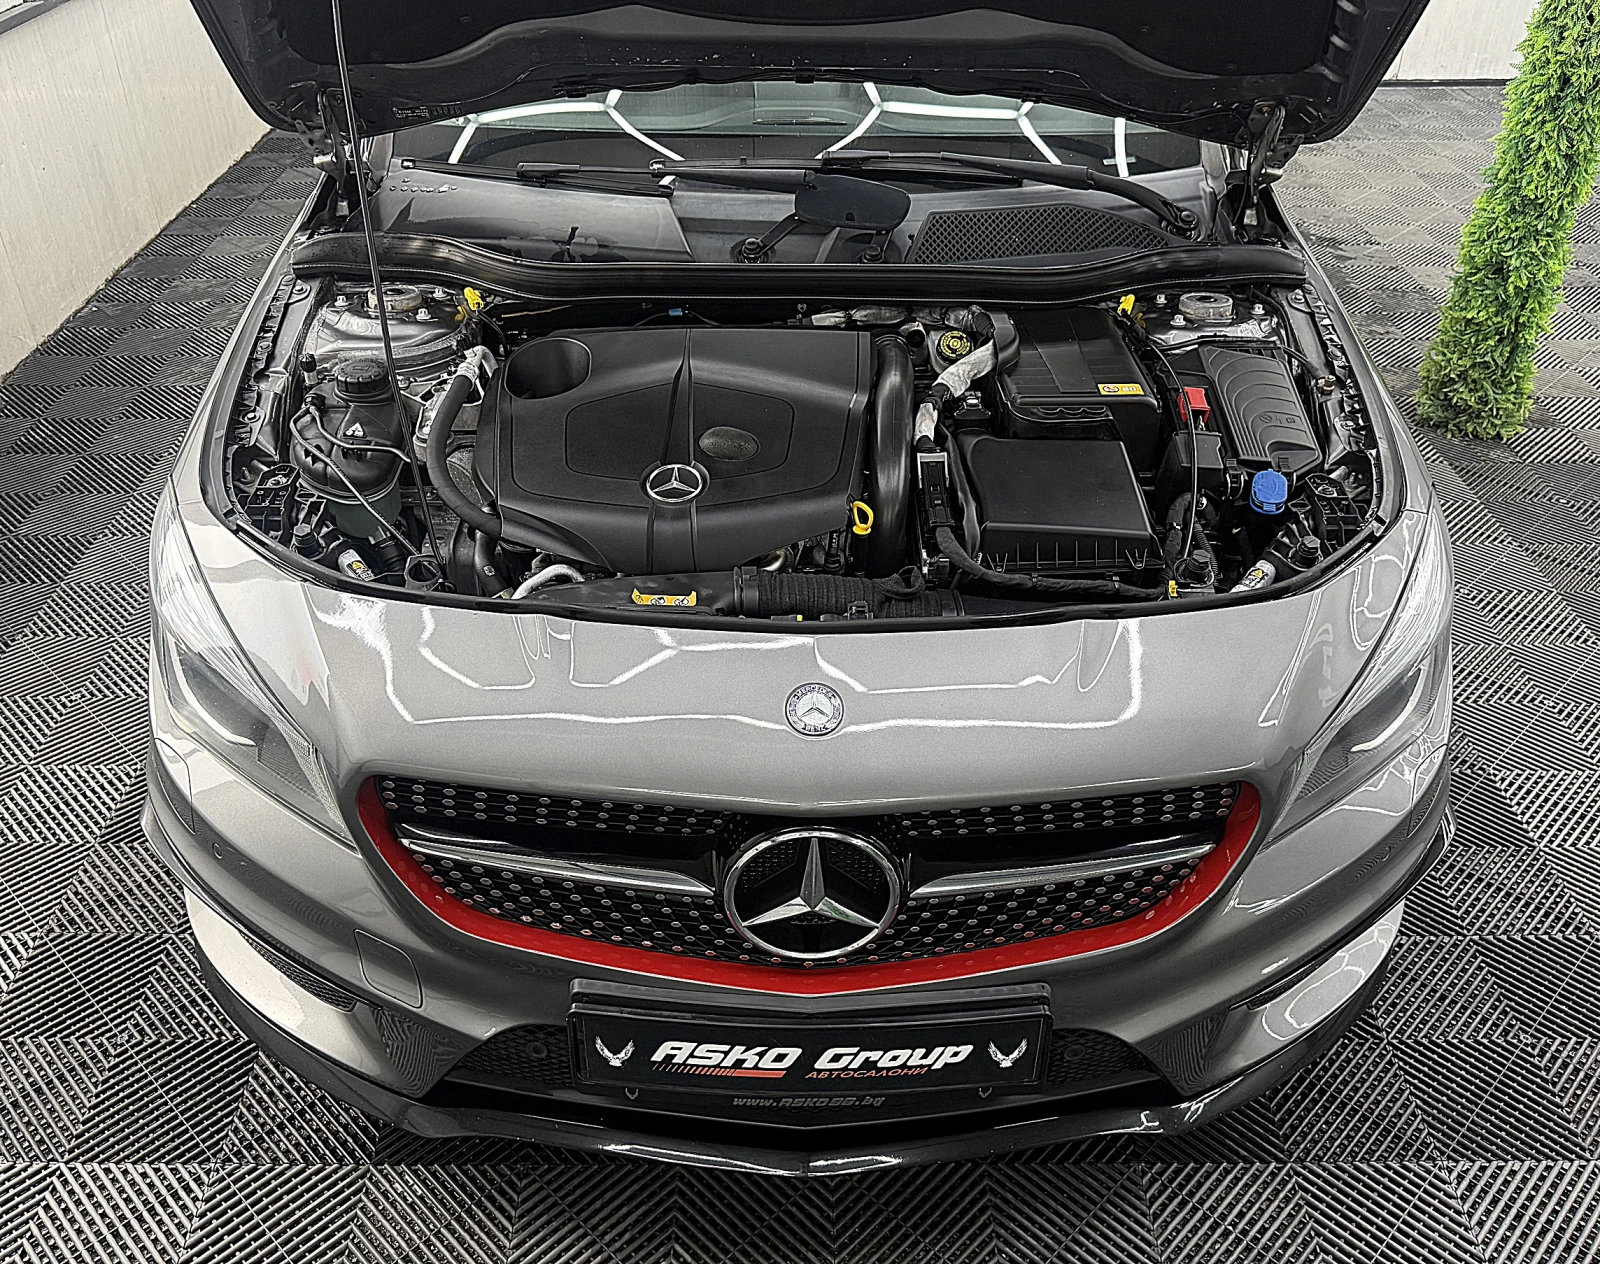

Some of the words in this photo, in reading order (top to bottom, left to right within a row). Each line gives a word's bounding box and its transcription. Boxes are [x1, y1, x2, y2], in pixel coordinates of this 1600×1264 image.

[651, 1041, 803, 1069] ASKO
[814, 1044, 974, 1070] Group
[805, 1066, 929, 1079] АВТОСАЛОНИ
